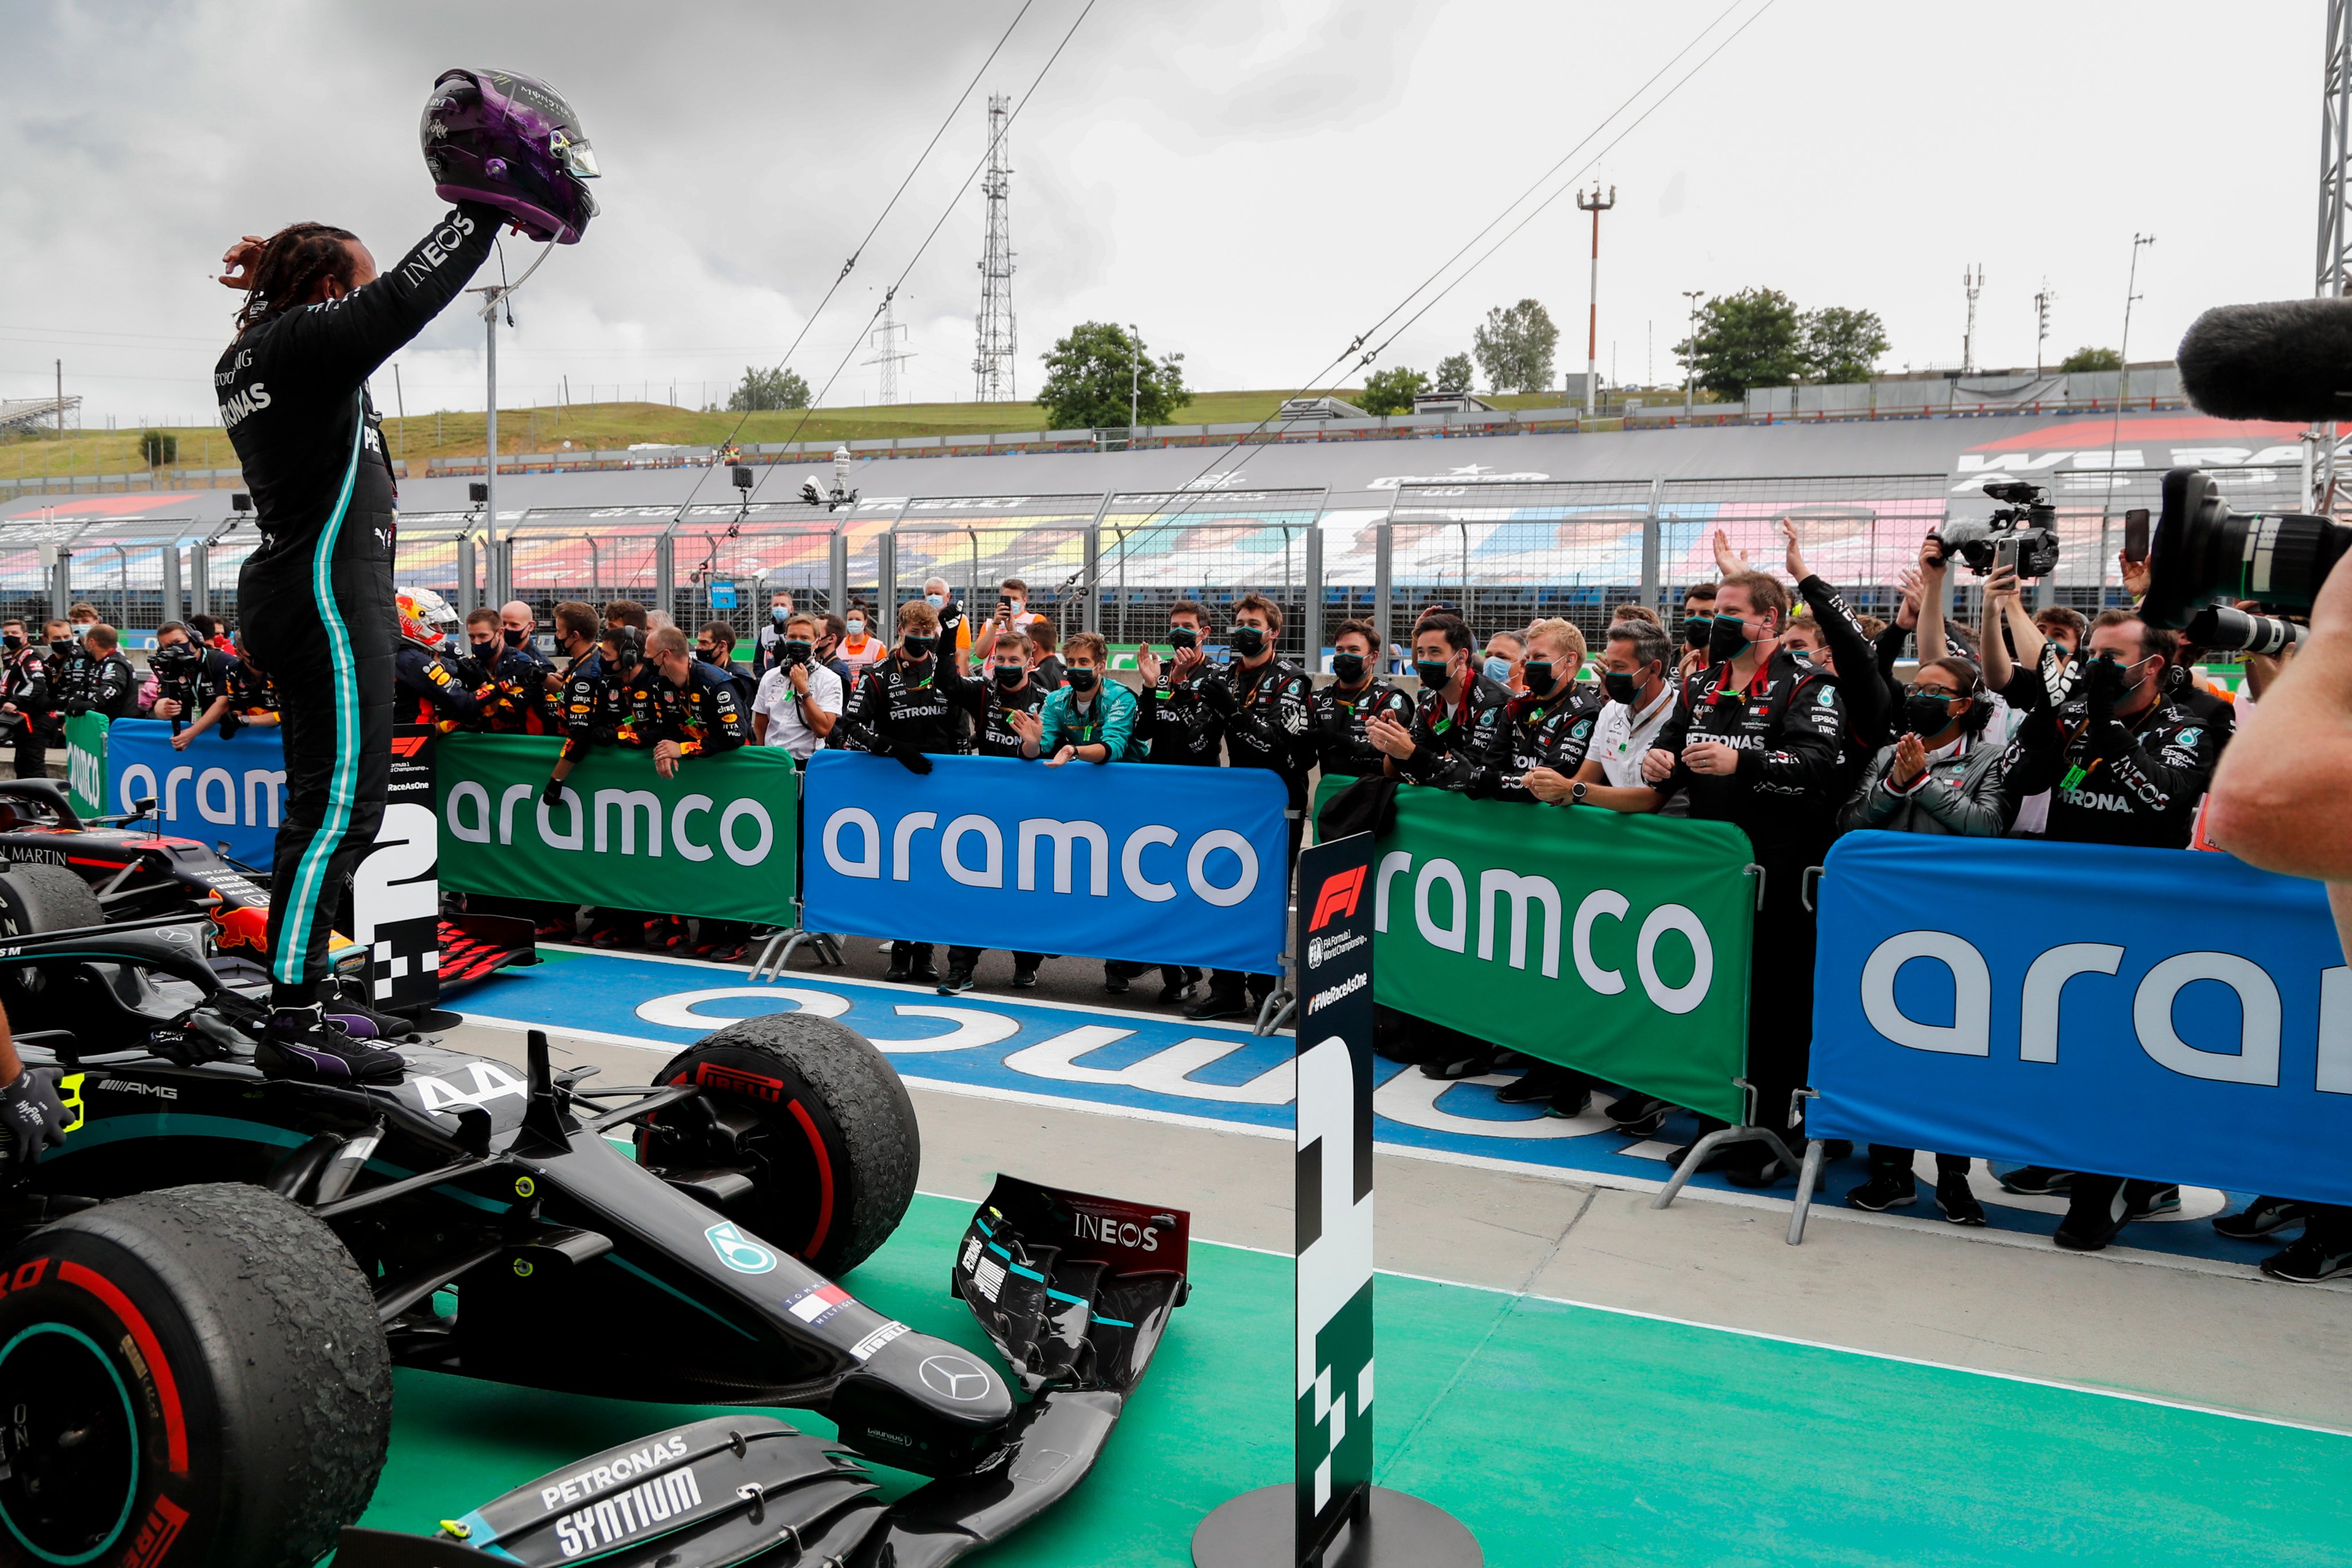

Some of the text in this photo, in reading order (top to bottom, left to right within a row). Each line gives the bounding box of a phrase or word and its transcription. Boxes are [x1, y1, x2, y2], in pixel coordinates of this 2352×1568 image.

[521, 86, 570, 118] MONSTER
[401, 212, 474, 288] INEOS
[219, 383, 272, 429] TRONAS
[1957, 445, 2352, 473] WE RA
[890, 706, 947, 720] PETRONAS
[1701, 705, 1714, 713] UBS
[1811, 706, 1839, 715] PETRONAS
[1812, 715, 1839, 726] EPSON
[985, 730, 1023, 746] PETRON
[1472, 738, 1487, 748] IWC
[1474, 731, 1493, 740] EPSON
[1818, 725, 1836, 735] IWC
[67, 741, 99, 810] aramco
[1560, 753, 1577, 765] IWC
[2161, 748, 2196, 765] EPSON
[120, 764, 287, 828] aram
[388, 782, 429, 792] RaceAsOne
[2110, 755, 2170, 811] INEOS
[446, 780, 773, 866] aramco
[12, 846, 67, 867] MARTIN
[354, 803, 438, 946] 2
[822, 806, 1260, 908] aramco
[1309, 864, 1368, 932] F1
[1323, 936, 1331, 949] FIA
[1331, 931, 1348, 944] Formula
[1323, 935, 1364, 961] World Championship
[1374, 850, 1714, 1015] ramco
[1314, 972, 1367, 1012] #WeRaceAsOne
[1860, 929, 2352, 1095] ara
[123, 1082, 177, 1099] AMG
[412, 1062, 528, 1117] 44
[696, 1062, 783, 1103] PIRELLI
[16, 1099, 44, 1125] HyFlex
[1298, 1035, 1373, 1338] 1
[1074, 1213, 1158, 1252] INEOS
[962, 1236, 983, 1274] PETRONAS
[785, 1279, 827, 1306] TOMMY
[814, 1298, 856, 1326] HILFIGER
[850, 1321, 912, 1360] PIRELLI
[540, 1435, 688, 1510] PETRONAS
[118, 1493, 189, 1568] PIRE
[555, 1466, 702, 1558] SYNTIUM
